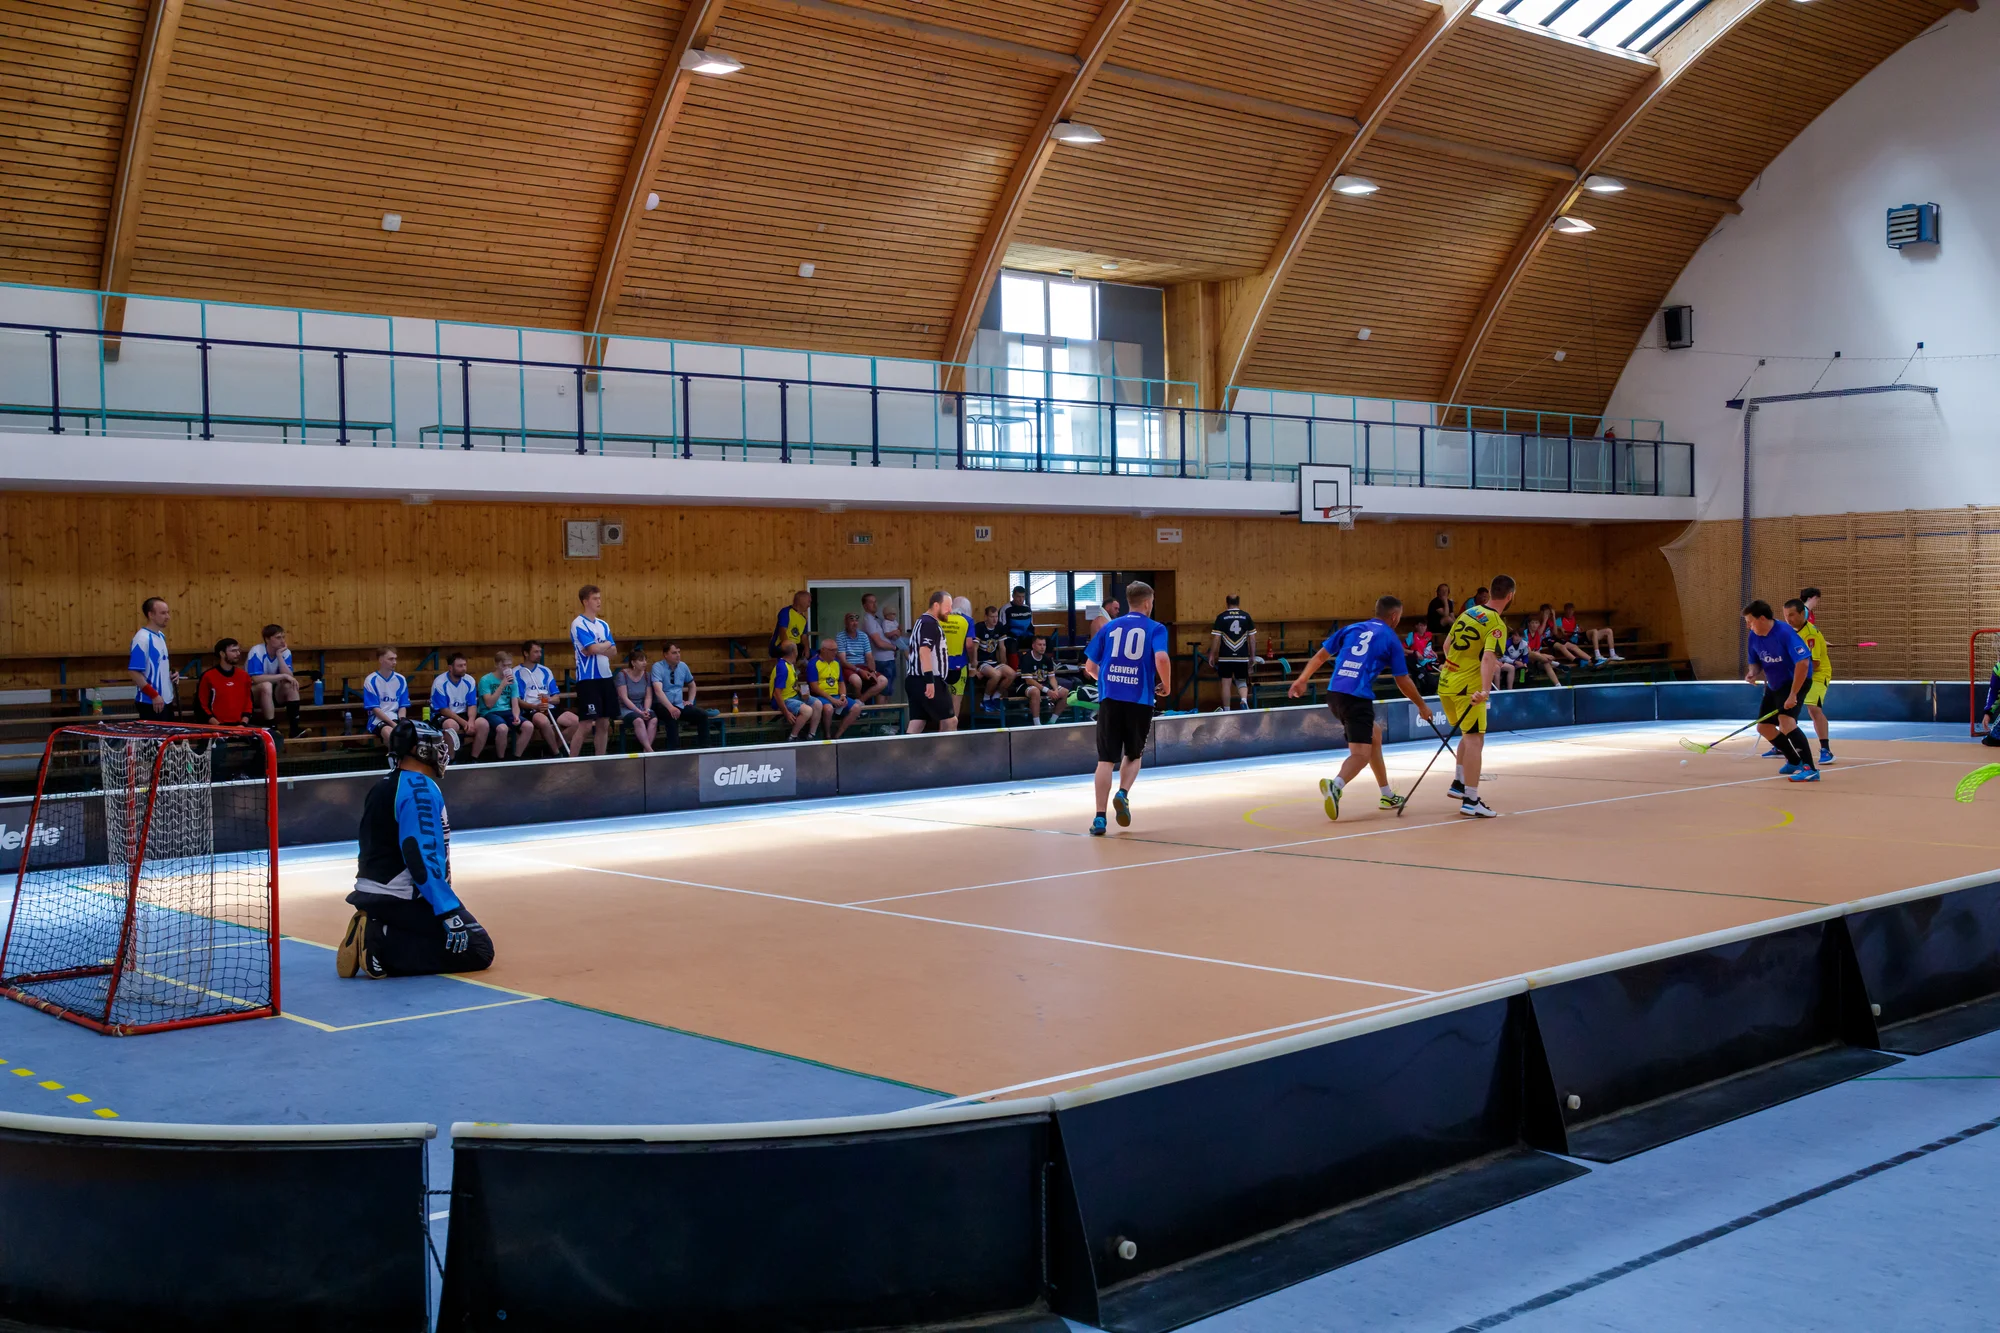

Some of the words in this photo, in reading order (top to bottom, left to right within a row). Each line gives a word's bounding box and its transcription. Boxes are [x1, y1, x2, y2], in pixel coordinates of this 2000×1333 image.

[1230, 619, 1242, 635] 4
[1109, 626, 1146, 660] 10
[1351, 630, 1374, 656] 3
[1107, 674, 1139, 685] KOSTELEC
[1109, 663, 1139, 675] ČERVENÝ
[713, 763, 782, 787] Gillette
[407, 774, 443, 880] SALMING
